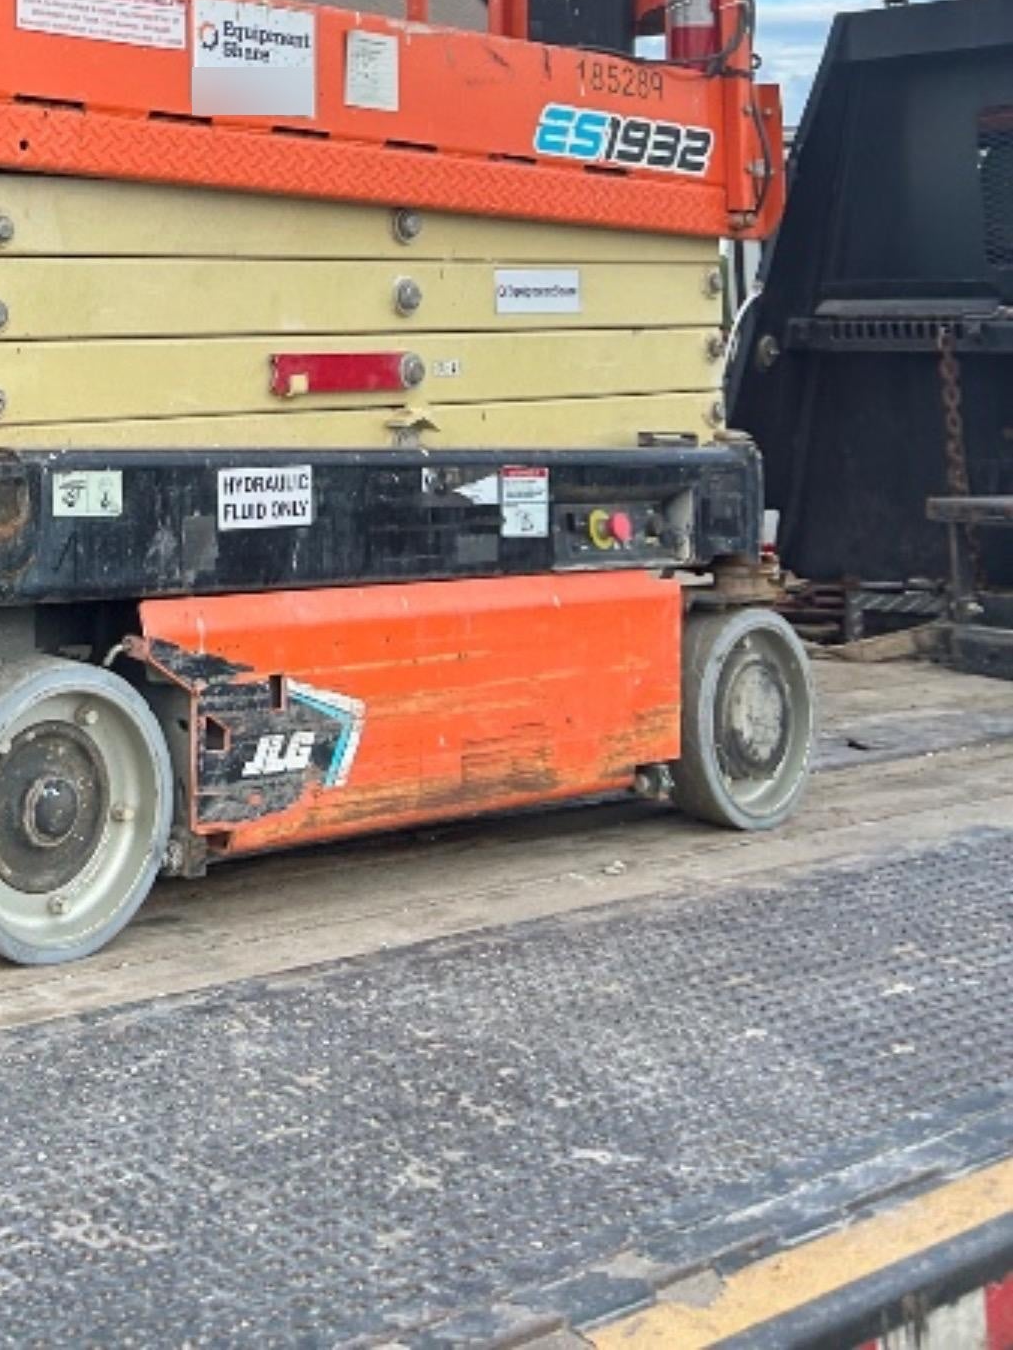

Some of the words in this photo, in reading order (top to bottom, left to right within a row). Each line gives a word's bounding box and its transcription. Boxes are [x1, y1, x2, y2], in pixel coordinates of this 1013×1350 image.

[577, 60, 663, 100] 185289
[536, 105, 711, 173] ES1932
[222, 473, 309, 495] HYDRAULIC
[223, 502, 267, 522] FLUID
[271, 499, 309, 519] ONLY
[242, 731, 315, 777] JLG
